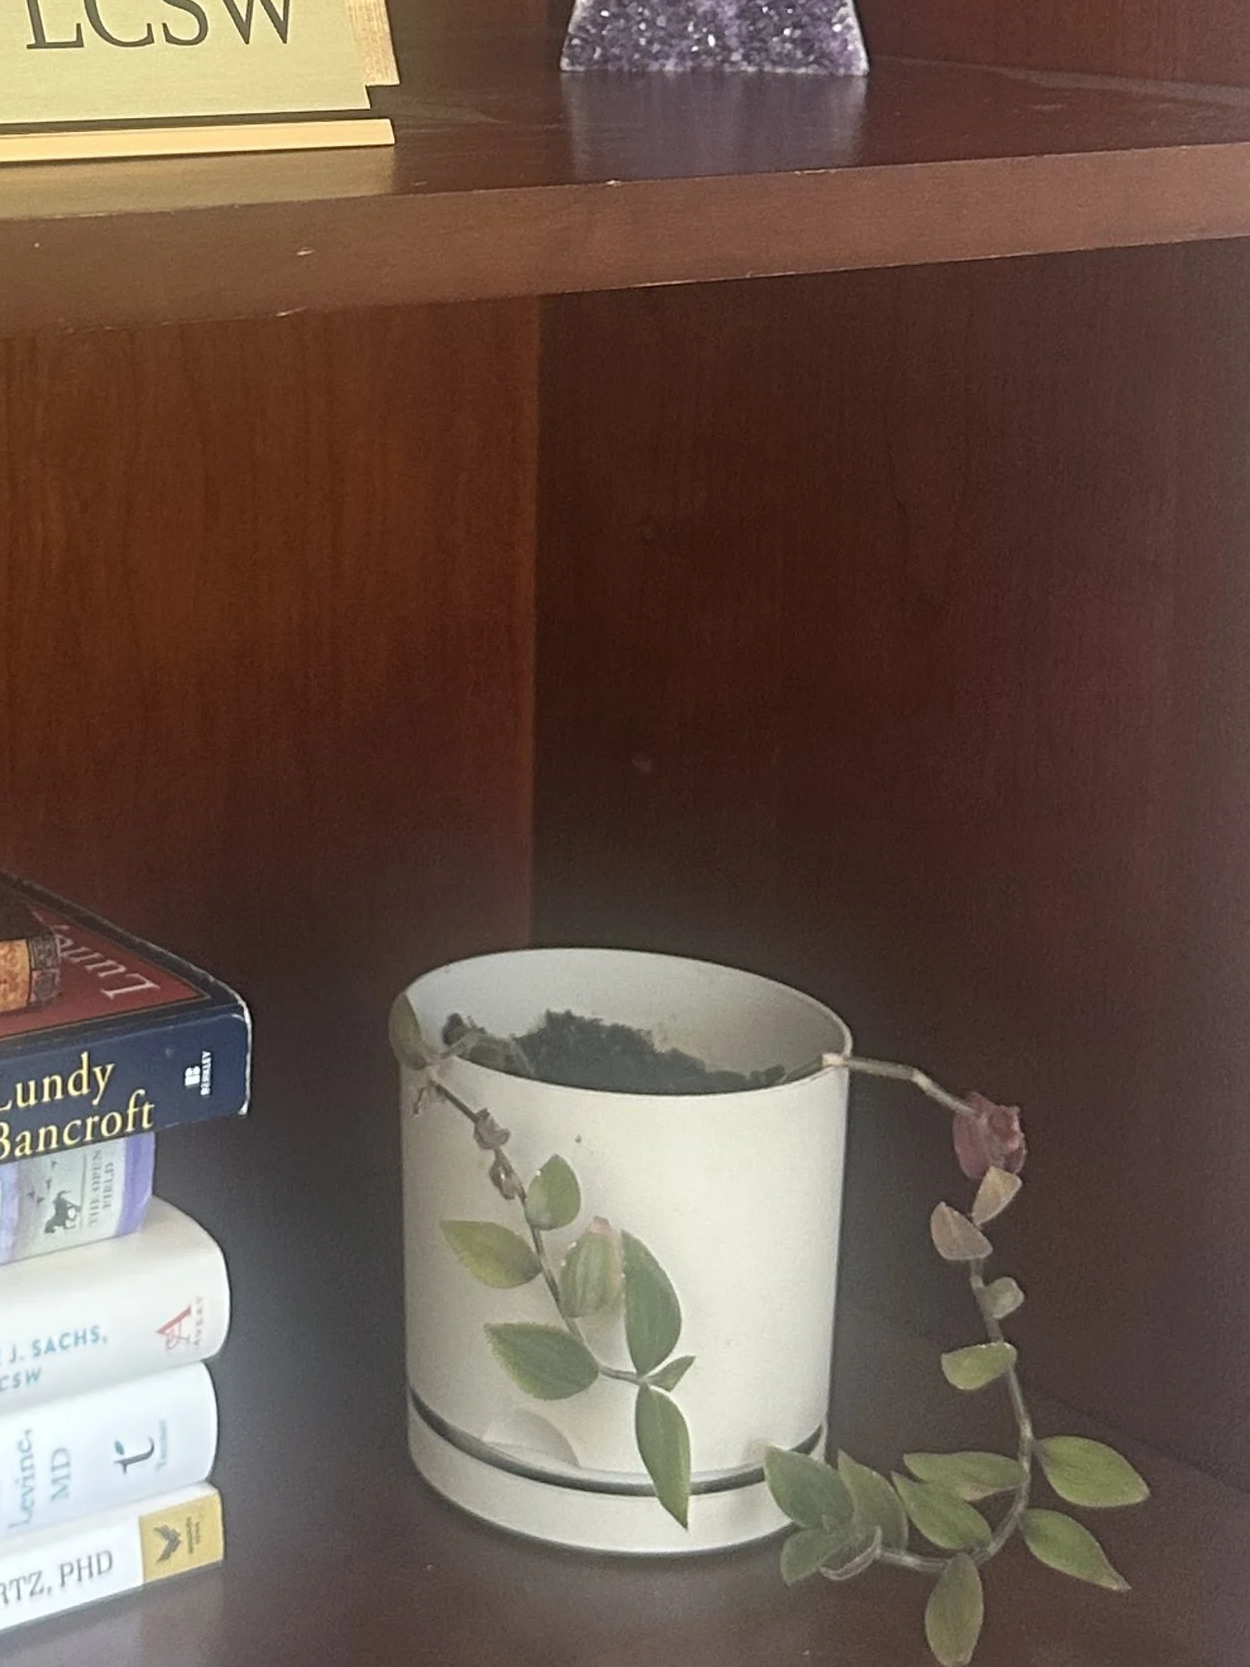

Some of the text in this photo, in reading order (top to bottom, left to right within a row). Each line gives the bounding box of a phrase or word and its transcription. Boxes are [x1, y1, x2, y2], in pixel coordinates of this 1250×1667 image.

[8, 1344, 24, 1364] J.
[31, 1324, 108, 1358] SACHS,
[49, 1446, 71, 1502] MD
[59, 1549, 114, 1587] PHD
